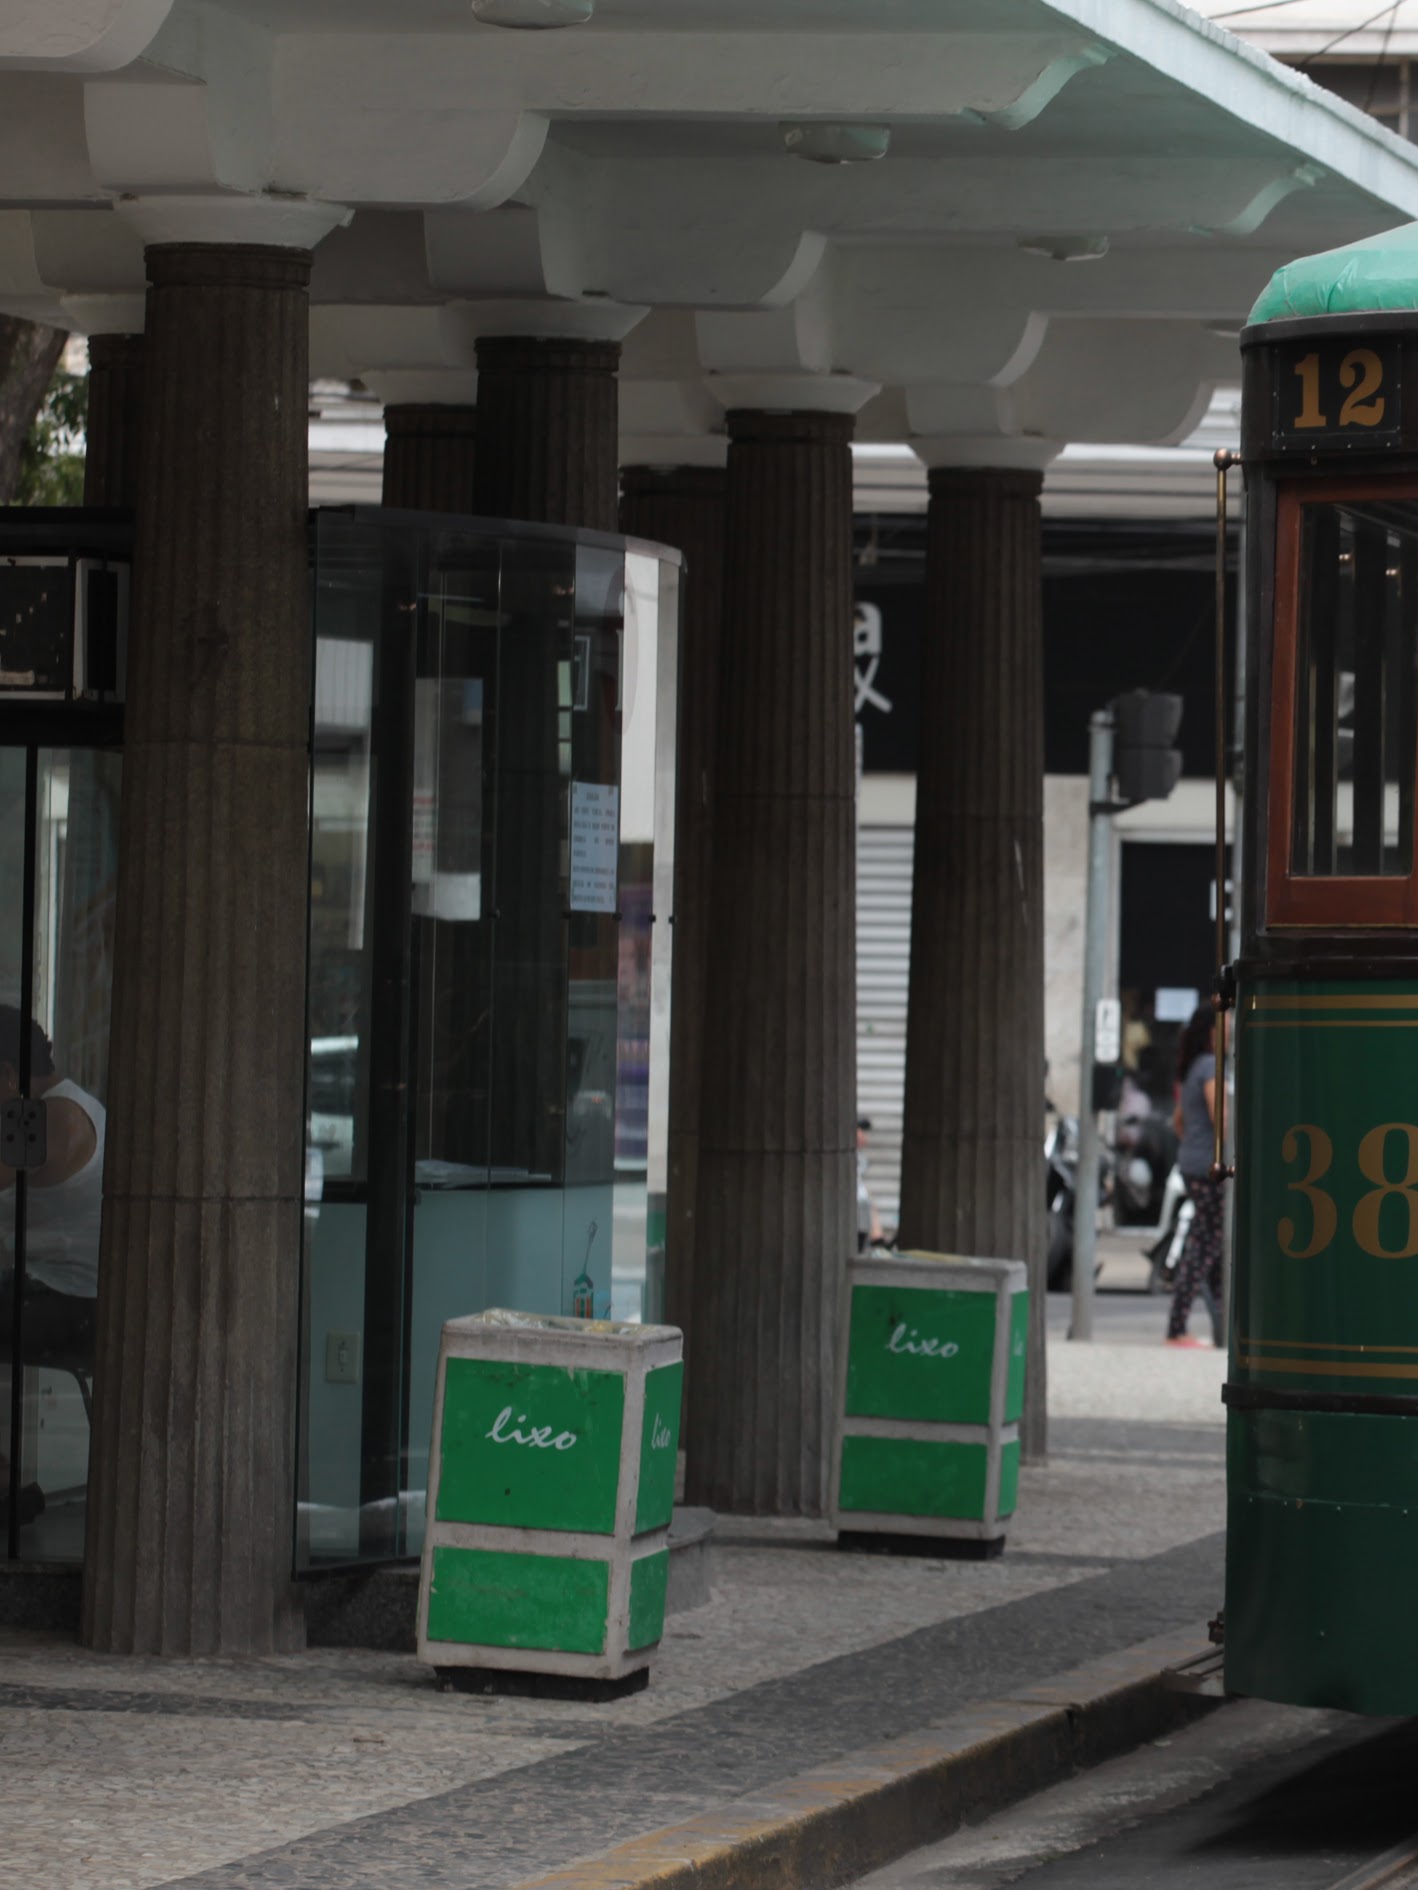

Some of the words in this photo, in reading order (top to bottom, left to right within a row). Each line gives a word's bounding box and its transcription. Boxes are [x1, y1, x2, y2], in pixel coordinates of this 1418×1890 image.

[1294, 349, 1385, 428] 12
[886, 1323, 959, 1358] lixo
[485, 1406, 577, 1450] lixo
